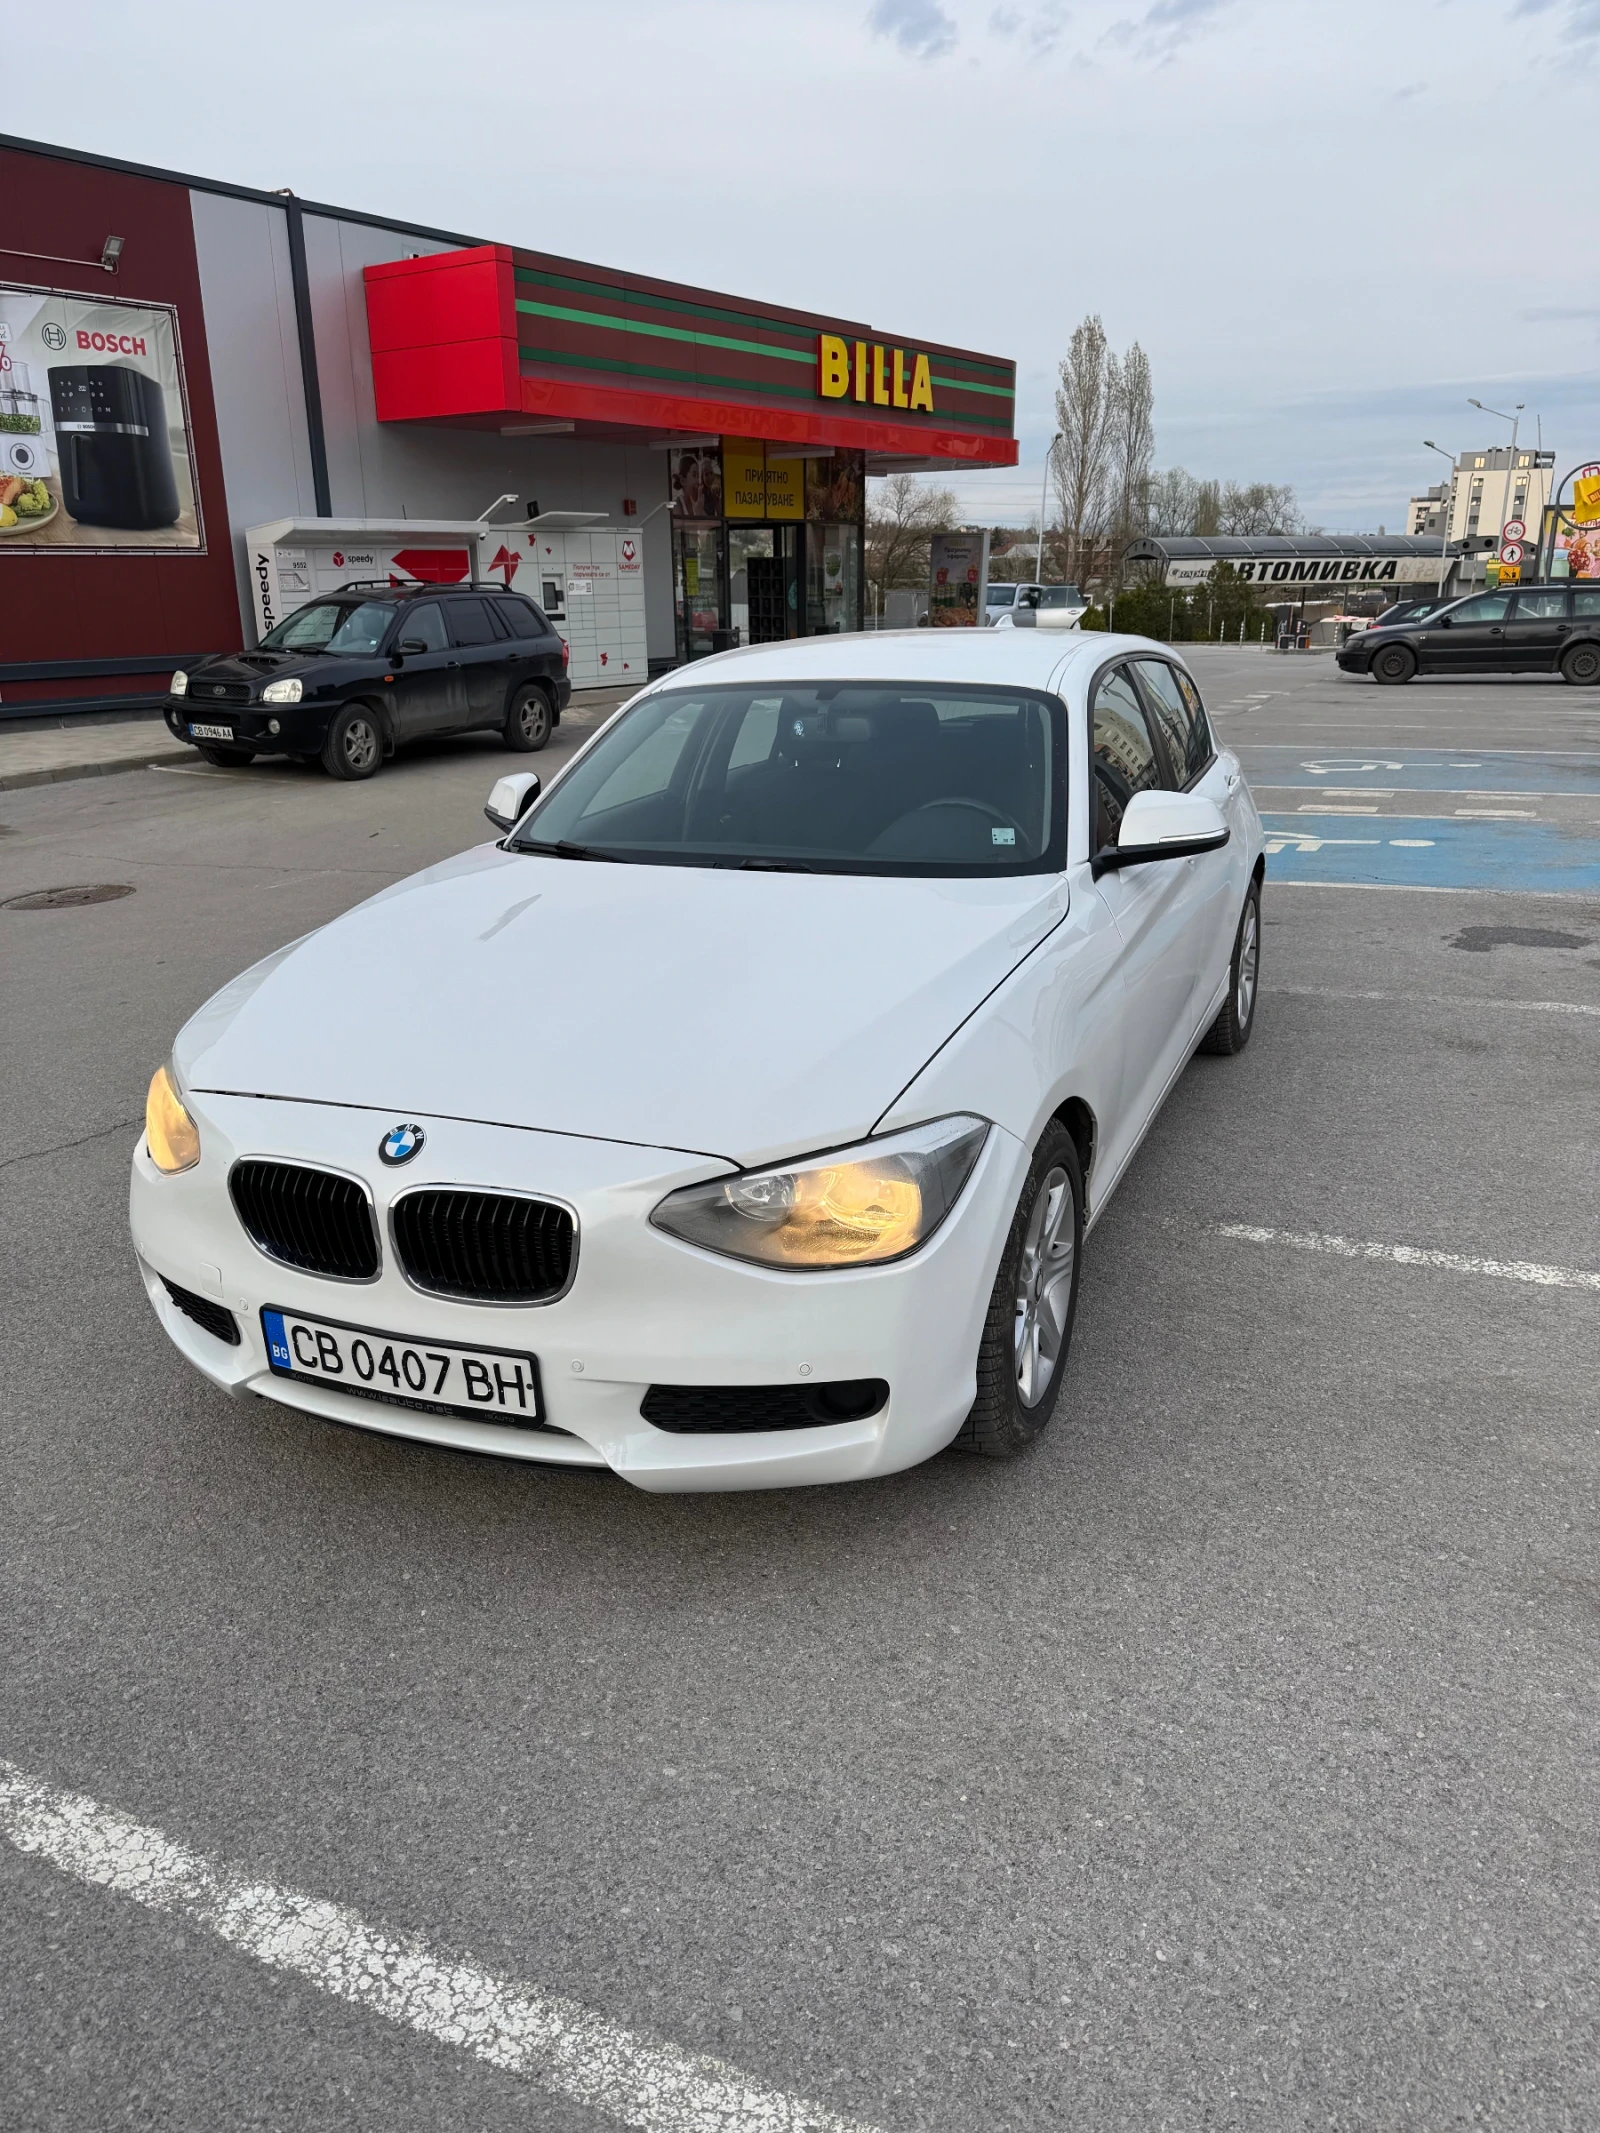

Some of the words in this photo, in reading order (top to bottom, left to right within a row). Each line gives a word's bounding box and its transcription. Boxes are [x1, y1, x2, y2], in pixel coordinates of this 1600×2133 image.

[76, 330, 147, 356] BOSCH
[818, 334, 934, 412] BILLA
[745, 468, 789, 484] ПРИЯТНО
[735, 491, 794, 507] ПАЗАРУВАНЕ
[347, 554, 374, 564] speedy
[1228, 560, 1398, 582] ВТОМИВКА
[256, 553, 275, 632] speedy
[223, 729, 232, 738] AA
[390, 1123, 425, 1140] BMW
[272, 1344, 288, 1360] BG
[291, 1325, 344, 1374] CB
[351, 1339, 451, 1396] 0407
[461, 1358, 527, 1409] BH
[346, 1386, 454, 1415] www.isauto.net
